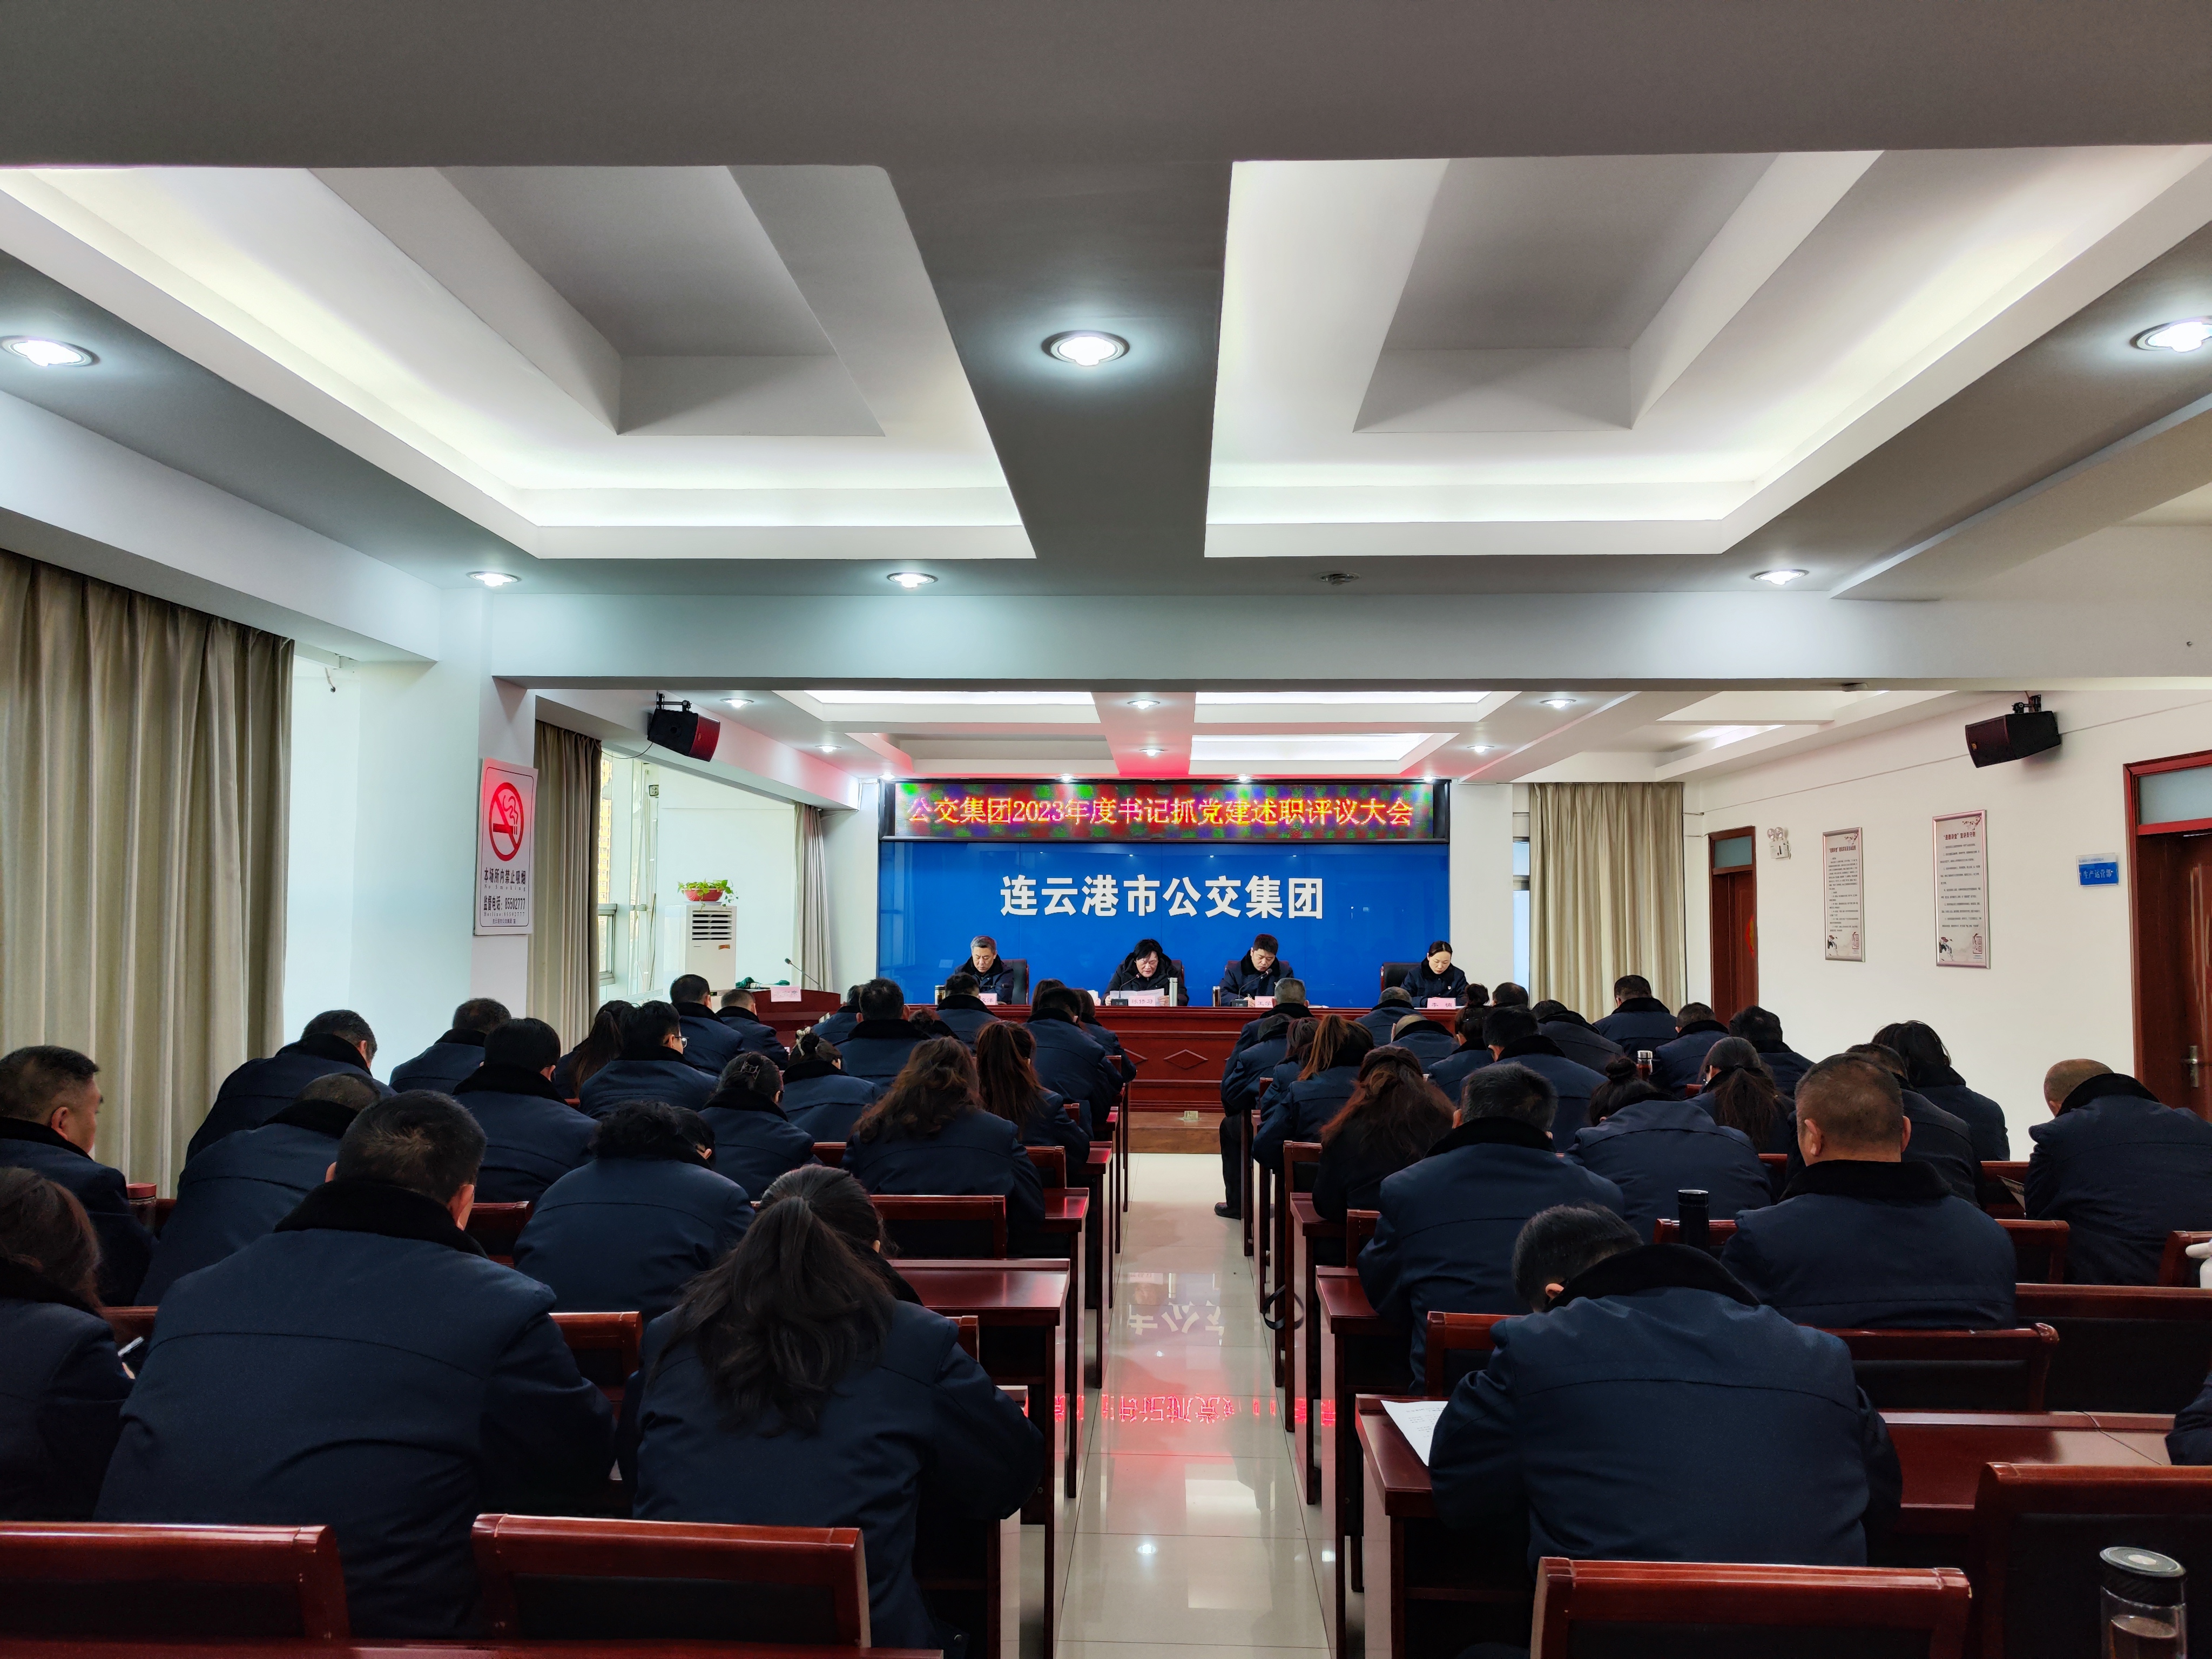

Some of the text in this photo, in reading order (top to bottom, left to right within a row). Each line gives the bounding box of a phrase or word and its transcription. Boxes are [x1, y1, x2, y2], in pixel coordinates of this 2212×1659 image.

[907, 797, 1414, 826] 公交集团2023年度书记抓党建述职评议大会
[484, 867, 526, 885] 本场所内禁止吸烟
[2083, 868, 2112, 879] 生产运营部
[1000, 874, 1323, 919] 连云港市公交集团
